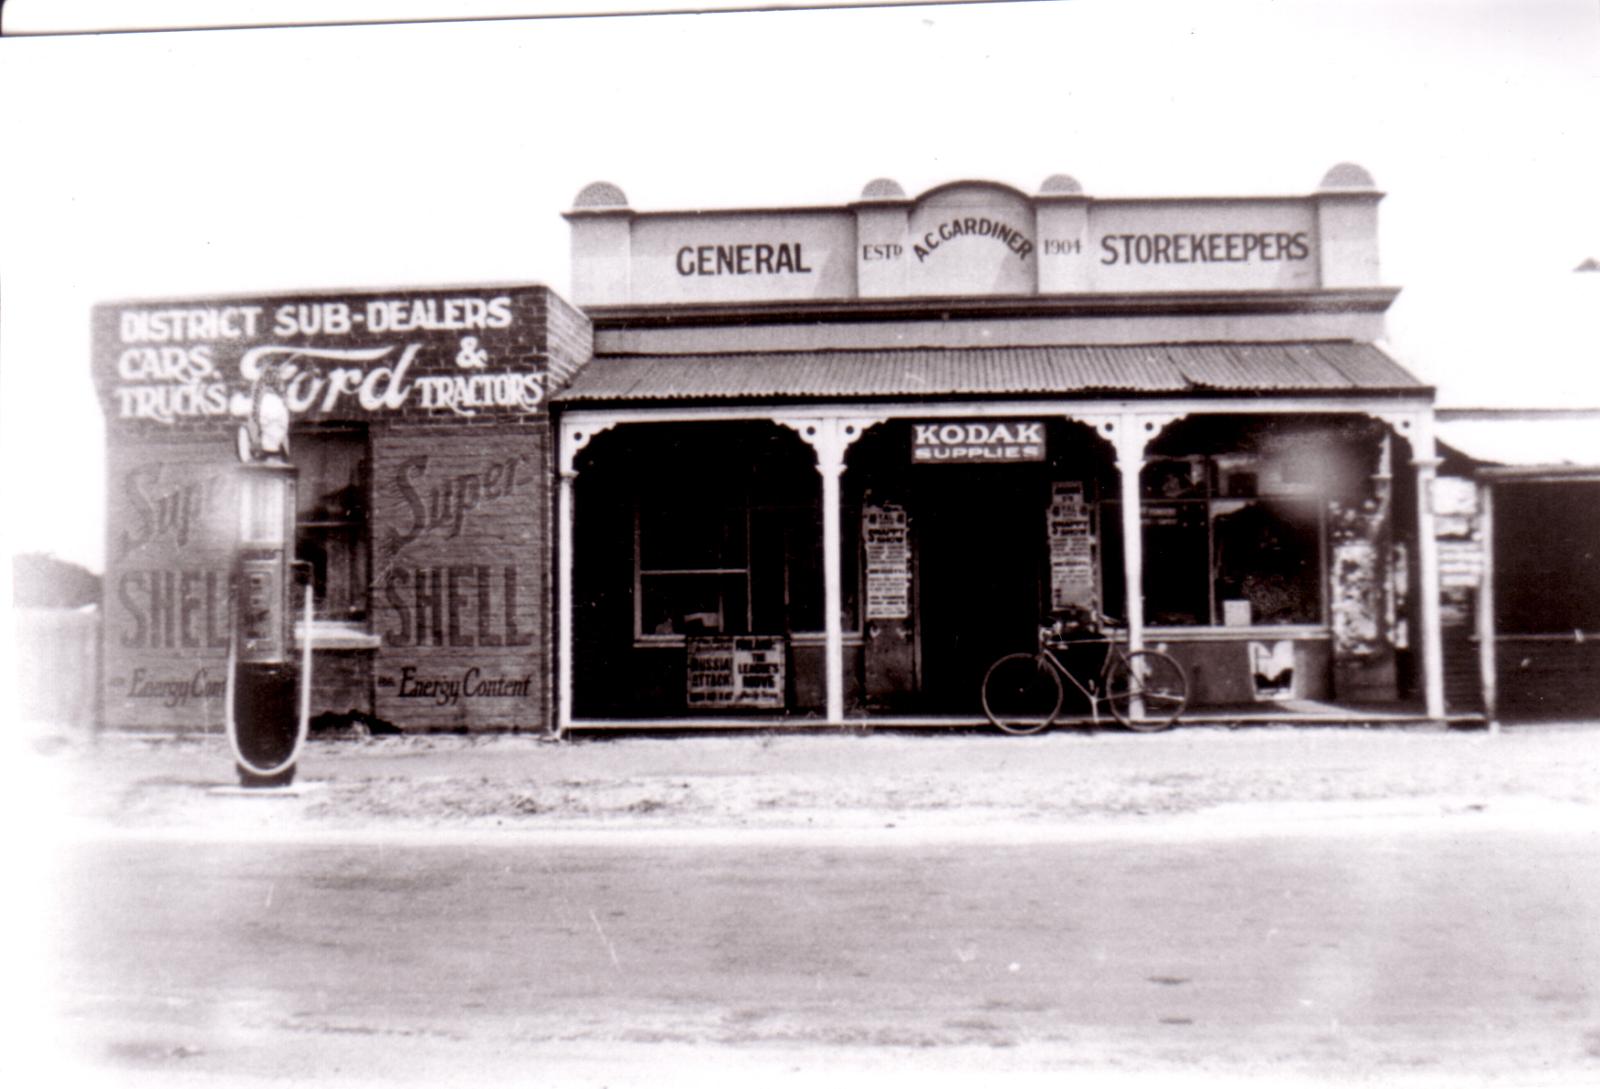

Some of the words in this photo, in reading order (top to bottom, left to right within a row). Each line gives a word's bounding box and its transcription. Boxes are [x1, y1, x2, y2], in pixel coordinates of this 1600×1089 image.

[939, 217, 1035, 261] GARDINER
[1044, 239, 1082, 255] 1904
[1100, 232, 1309, 265] STOREKEEPERS
[676, 243, 811, 276] GENERAL
[119, 305, 263, 343] DISTRICT
[273, 297, 512, 336] SUB-DEALERS
[456, 336, 489, 369] &
[230, 342, 423, 415] Ford
[415, 371, 546, 417] TRACTORS
[915, 423, 1042, 445] KODAK
[915, 446, 1039, 460] SUPPLIES
[118, 570, 230, 649] SHEL
[383, 566, 536, 647] SHELL
[398, 666, 460, 706] Energy
[463, 666, 532, 697] Content
